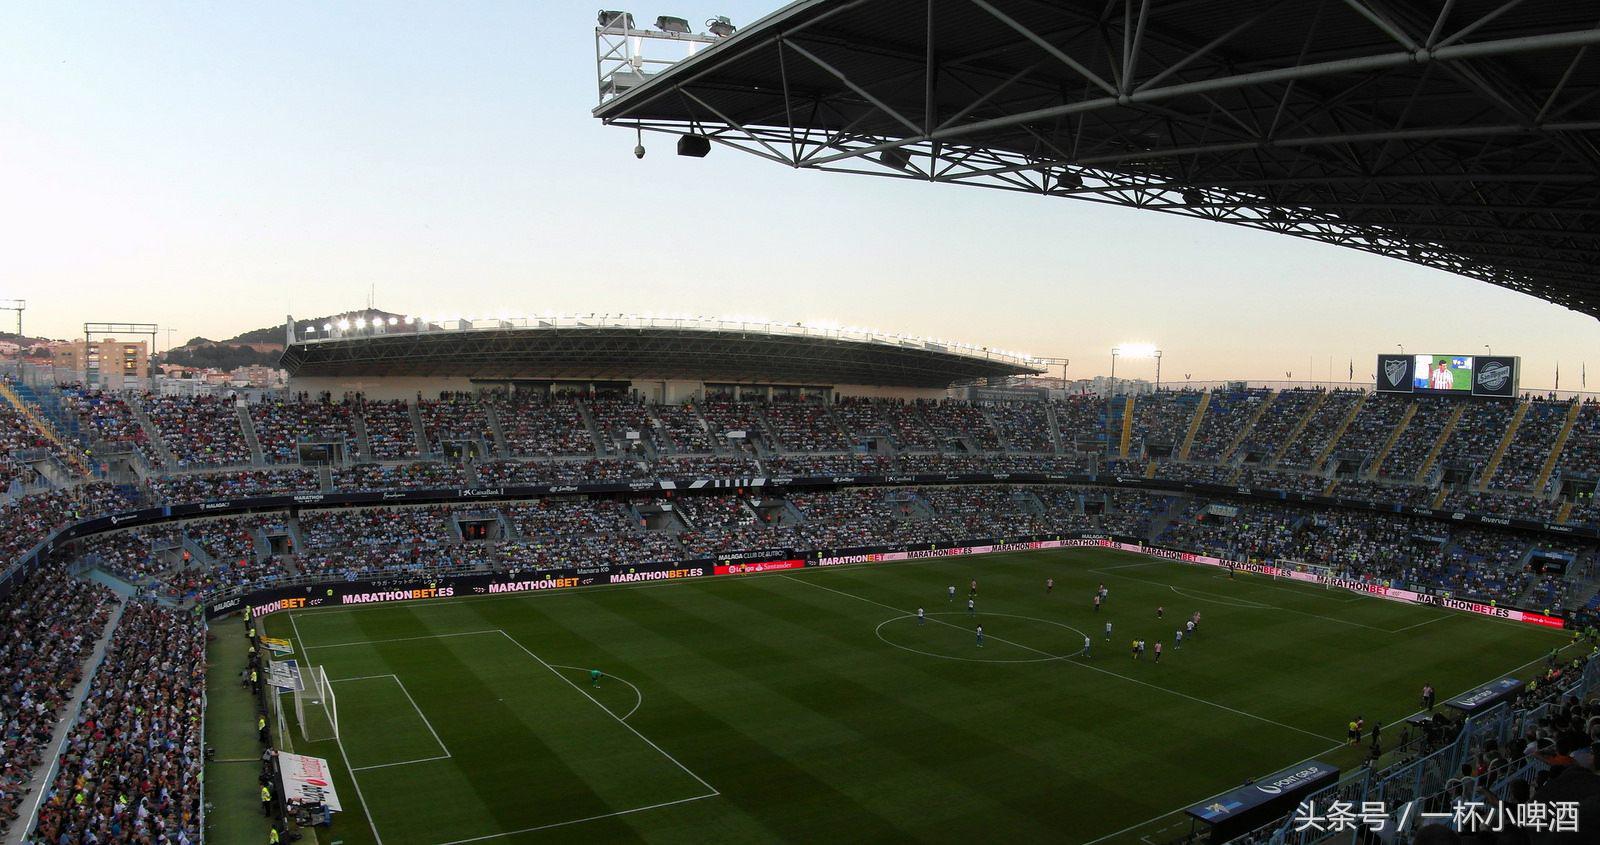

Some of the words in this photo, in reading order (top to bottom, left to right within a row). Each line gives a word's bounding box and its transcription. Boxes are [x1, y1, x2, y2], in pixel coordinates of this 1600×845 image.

[907, 547, 972, 559] MARATHONBET.ES
[992, 541, 1042, 552] MARATHONBET
[1140, 546, 1197, 562] MARATHONBET
[819, 554, 884, 566] MARATHONBET
[1219, 559, 1291, 577] MARATHONBET.ES
[610, 568, 703, 583] MARATHONBET.ES
[489, 577, 580, 593] MARATHONBET
[1317, 575, 1389, 595] MARATHONBET
[342, 587, 454, 604] MARATHONBET.ES
